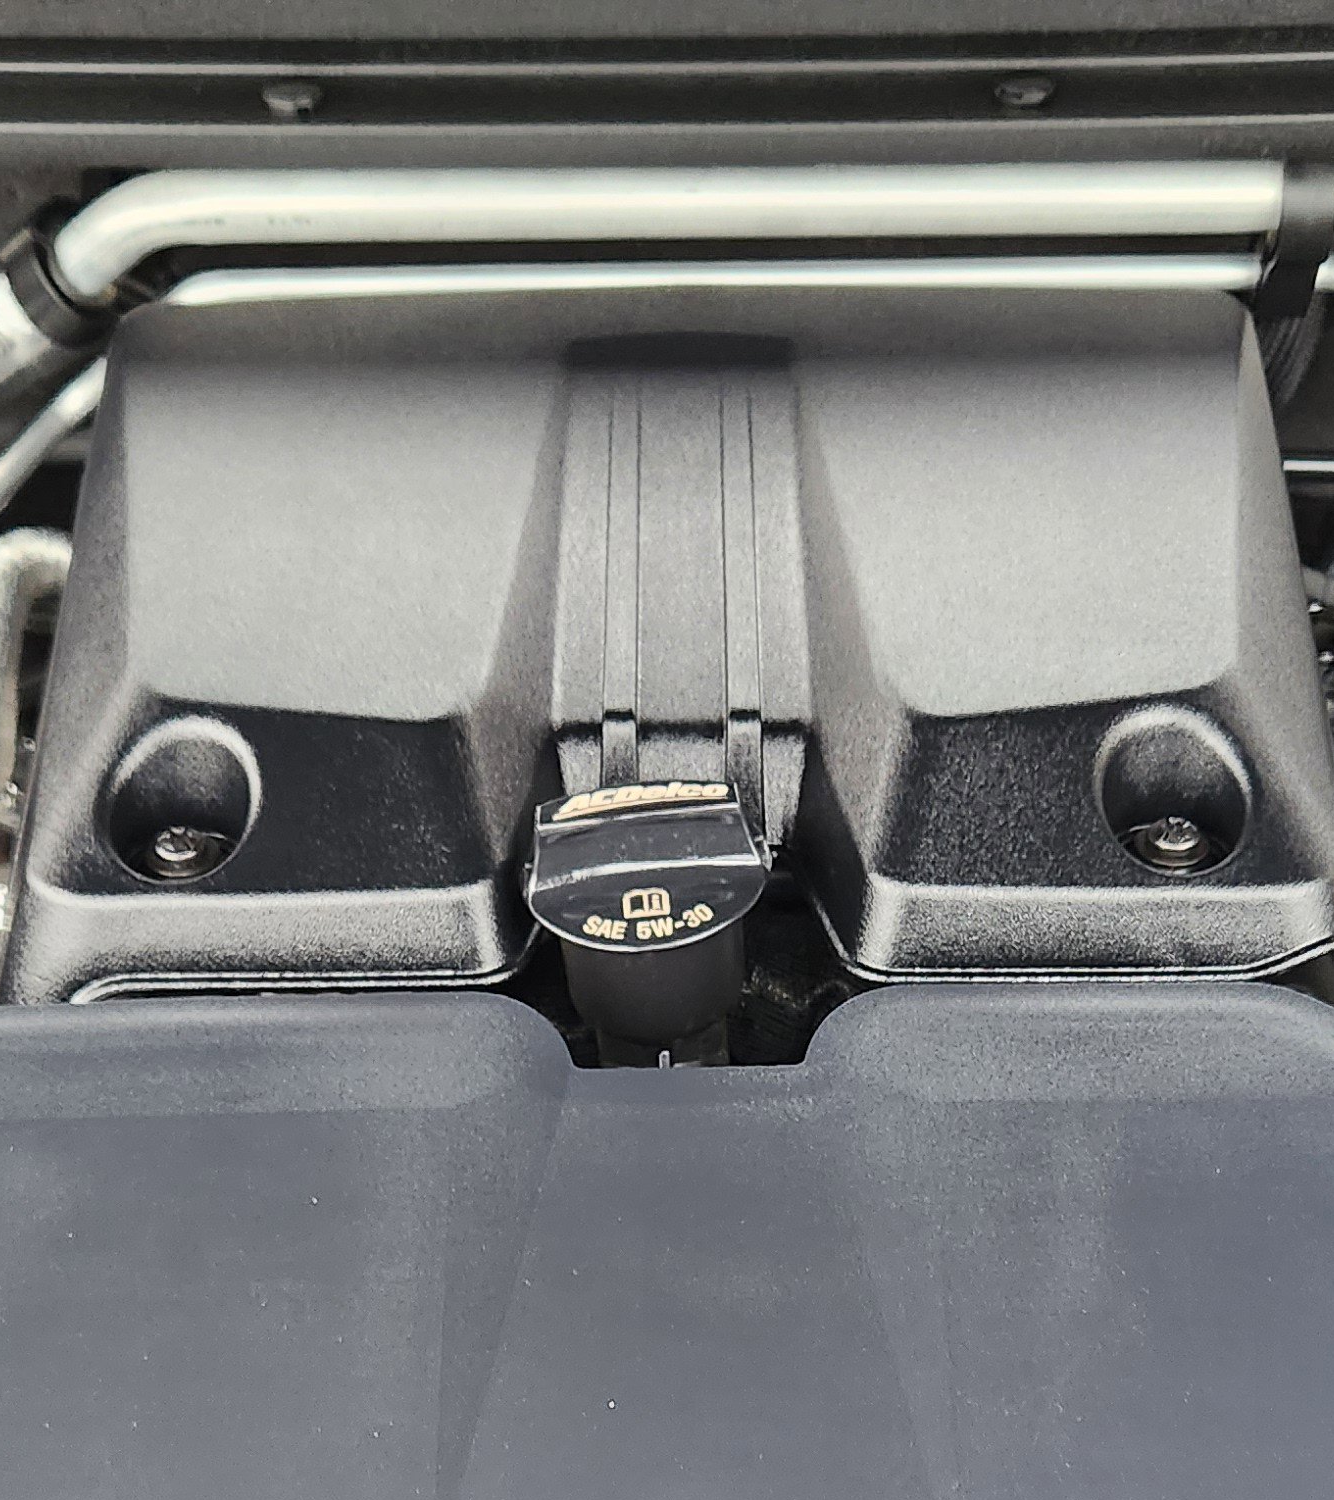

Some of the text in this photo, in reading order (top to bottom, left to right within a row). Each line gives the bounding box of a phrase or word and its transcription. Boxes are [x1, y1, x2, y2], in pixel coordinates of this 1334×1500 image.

[552, 781, 729, 821] ACDelco
[582, 903, 714, 940] SAE 5W-30
